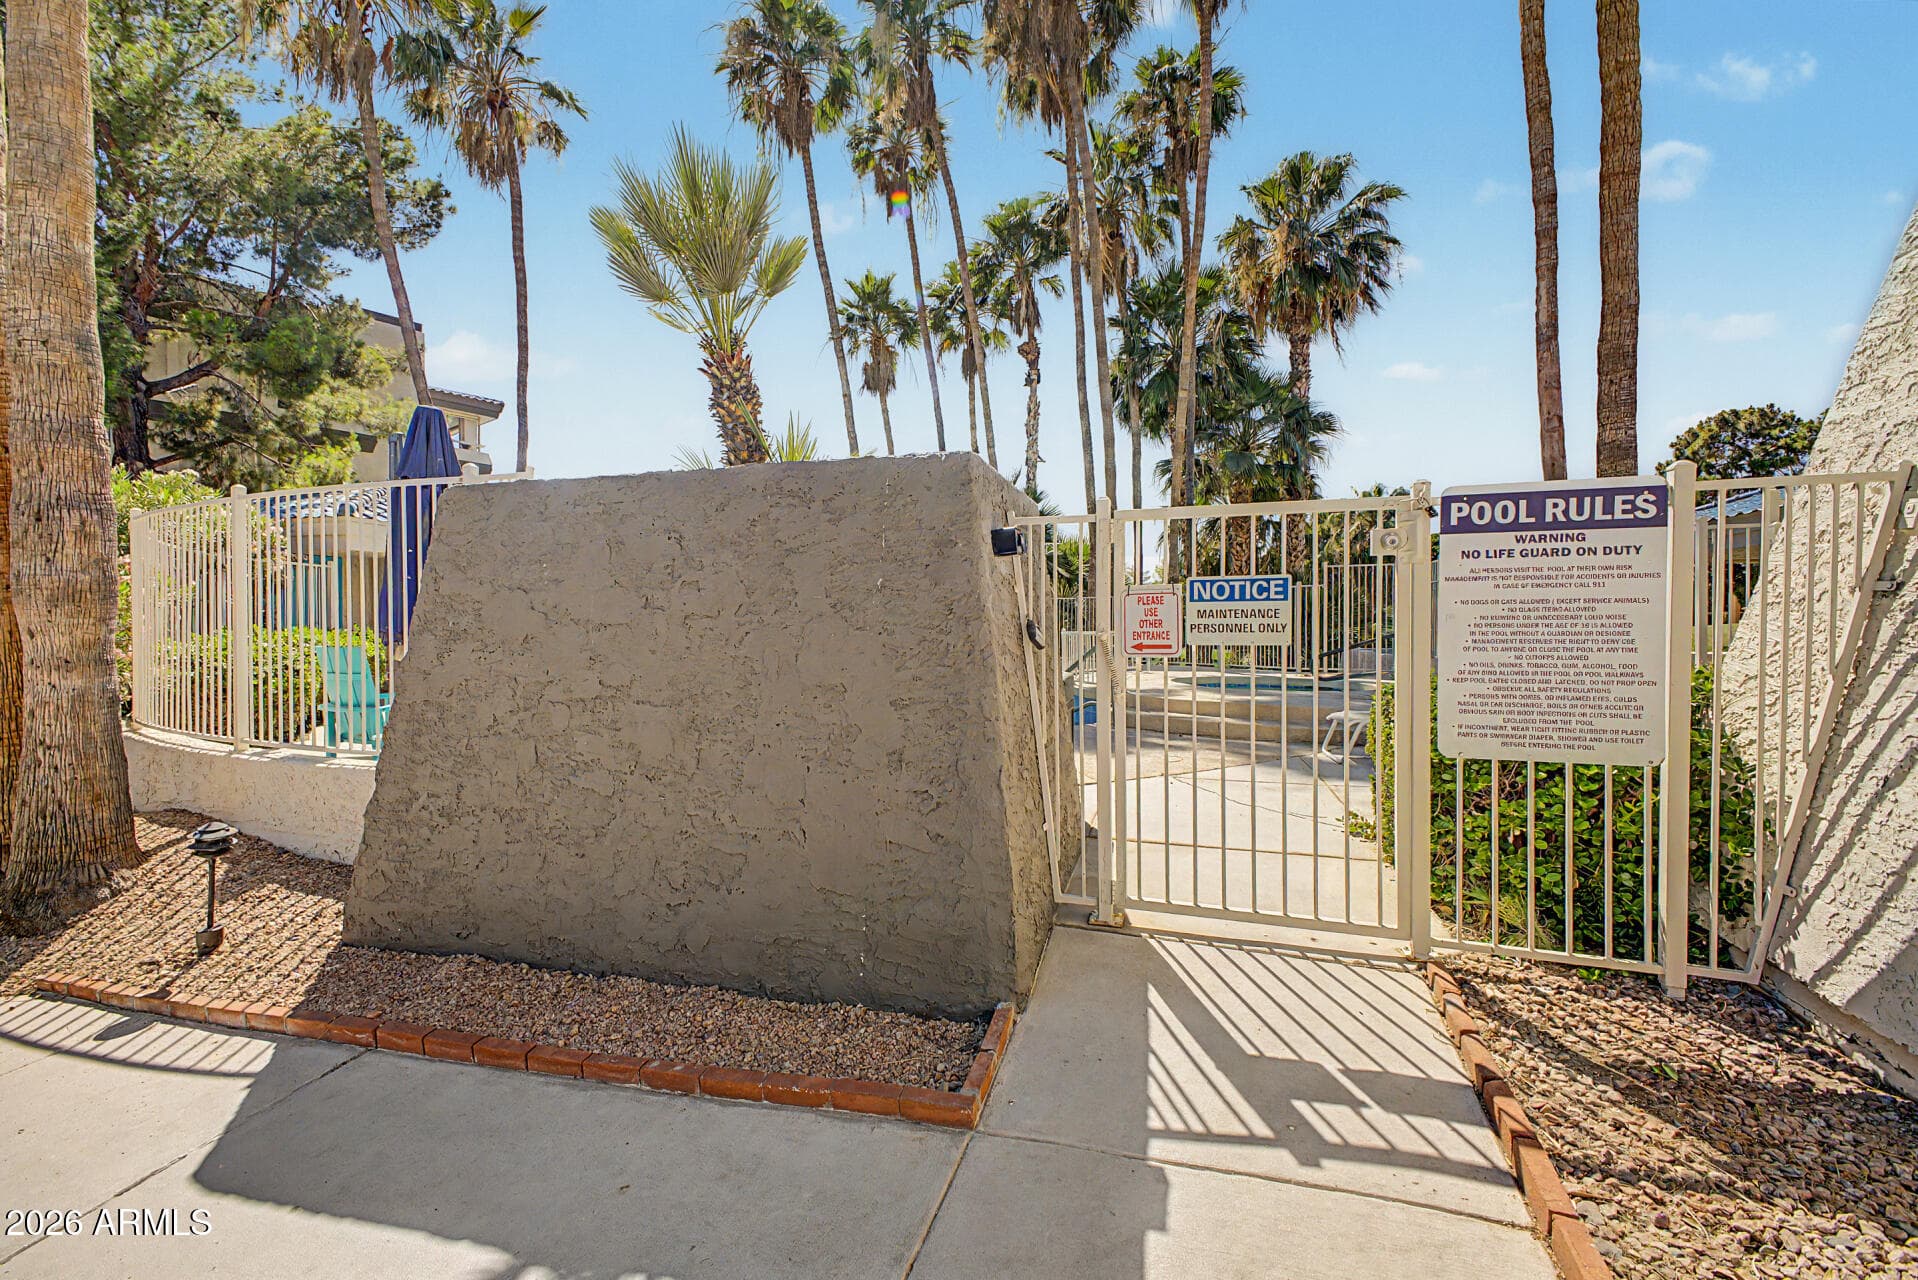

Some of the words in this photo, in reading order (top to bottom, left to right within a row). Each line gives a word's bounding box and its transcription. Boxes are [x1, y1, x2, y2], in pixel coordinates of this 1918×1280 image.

[1450, 500, 1536, 526] POOL
[1545, 493, 1658, 522] RULES
[1514, 532, 1586, 544] WARNING
[1461, 550, 1481, 559] NO
[1486, 549, 1515, 559] LIFE
[1519, 547, 1571, 558] GUARD
[1576, 546, 1598, 556] ON
[1603, 545, 1643, 555] DUTY
[1193, 580, 1284, 600] NOTICE
[1137, 596, 1164, 606] PLEASE
[1144, 608, 1158, 617] USE
[1197, 608, 1280, 619] MAINTENANCE
[1139, 620, 1162, 628] OTHER
[1190, 623, 1254, 634] PERSONNEL
[1258, 623, 1287, 633] ONLY
[1132, 631, 1170, 641] ENTRANCE
